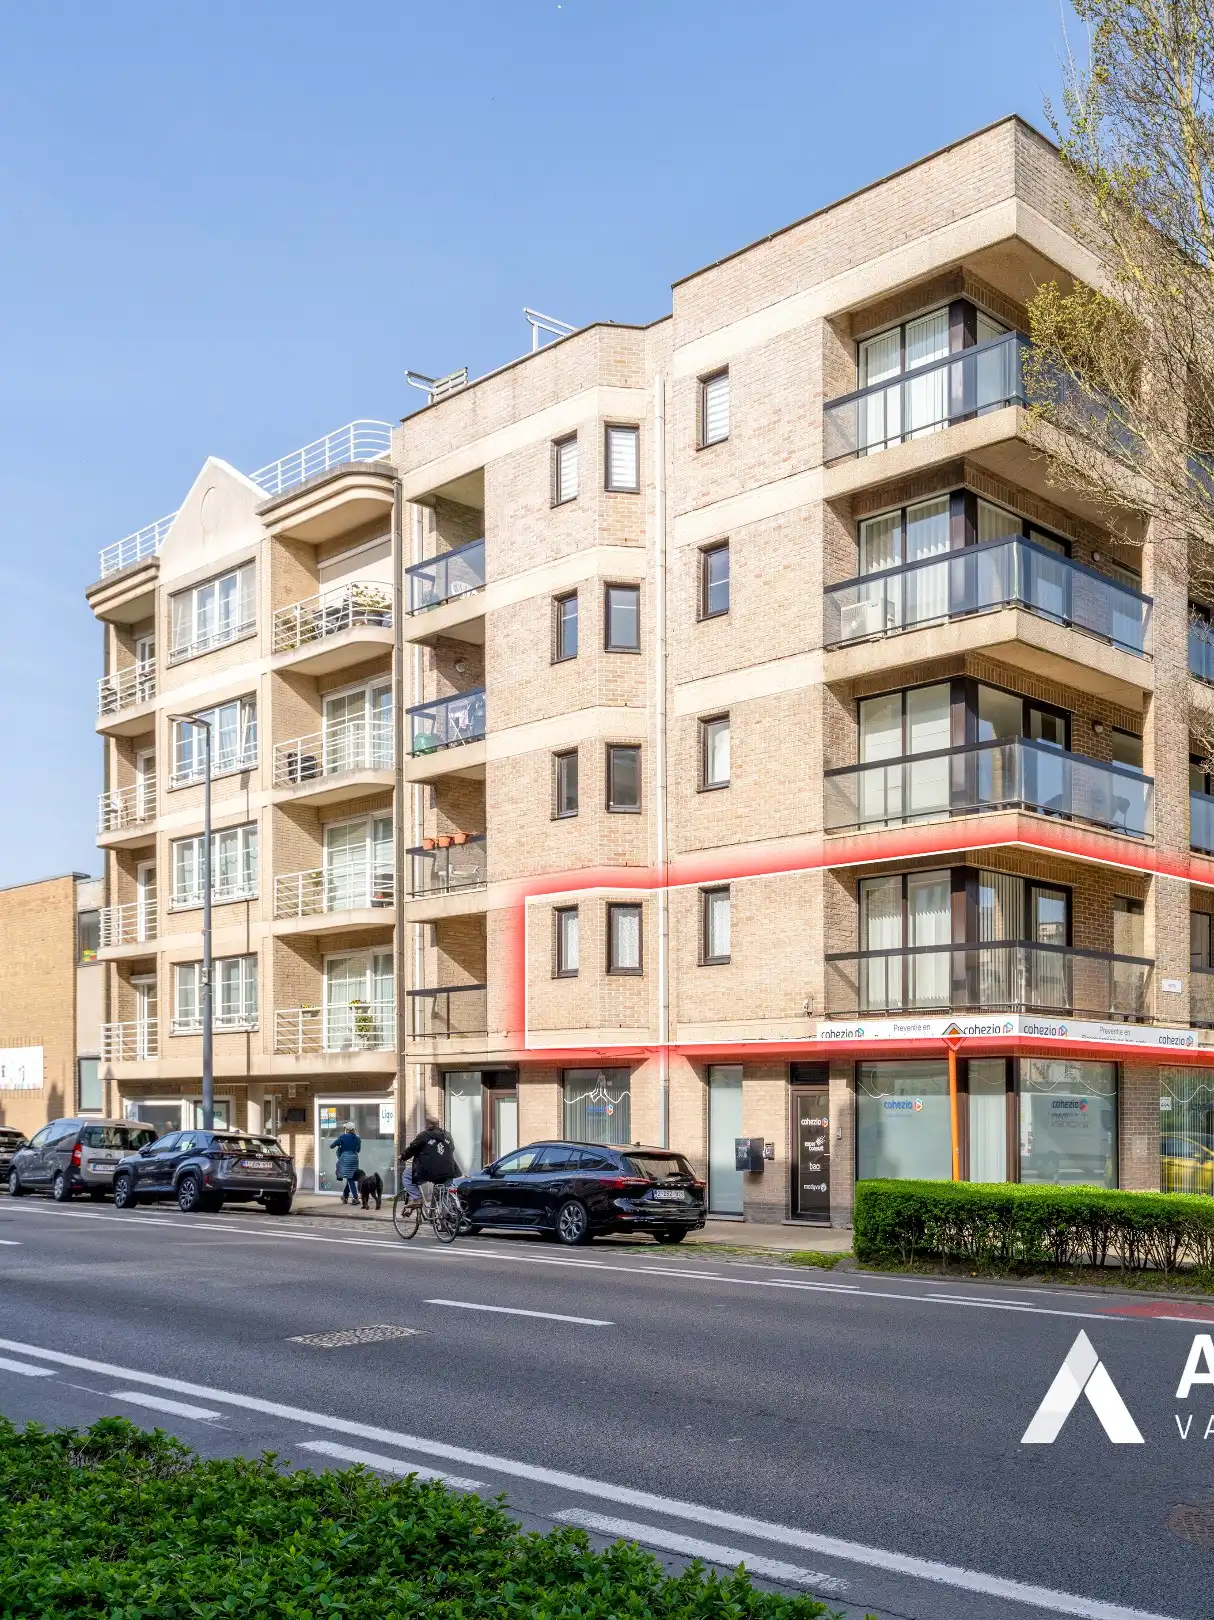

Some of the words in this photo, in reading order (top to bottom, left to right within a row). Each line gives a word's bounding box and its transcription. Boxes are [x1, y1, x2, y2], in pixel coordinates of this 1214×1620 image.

[893, 1023, 921, 1032] Preventie
[963, 1024, 1001, 1035] cohezio
[1023, 1024, 1057, 1036] cohezio
[1100, 1026, 1123, 1035] Preventie
[821, 1028, 853, 1039] cohezio
[1158, 1034, 1186, 1046] cohezio
[1052, 1099, 1079, 1109] cohezio
